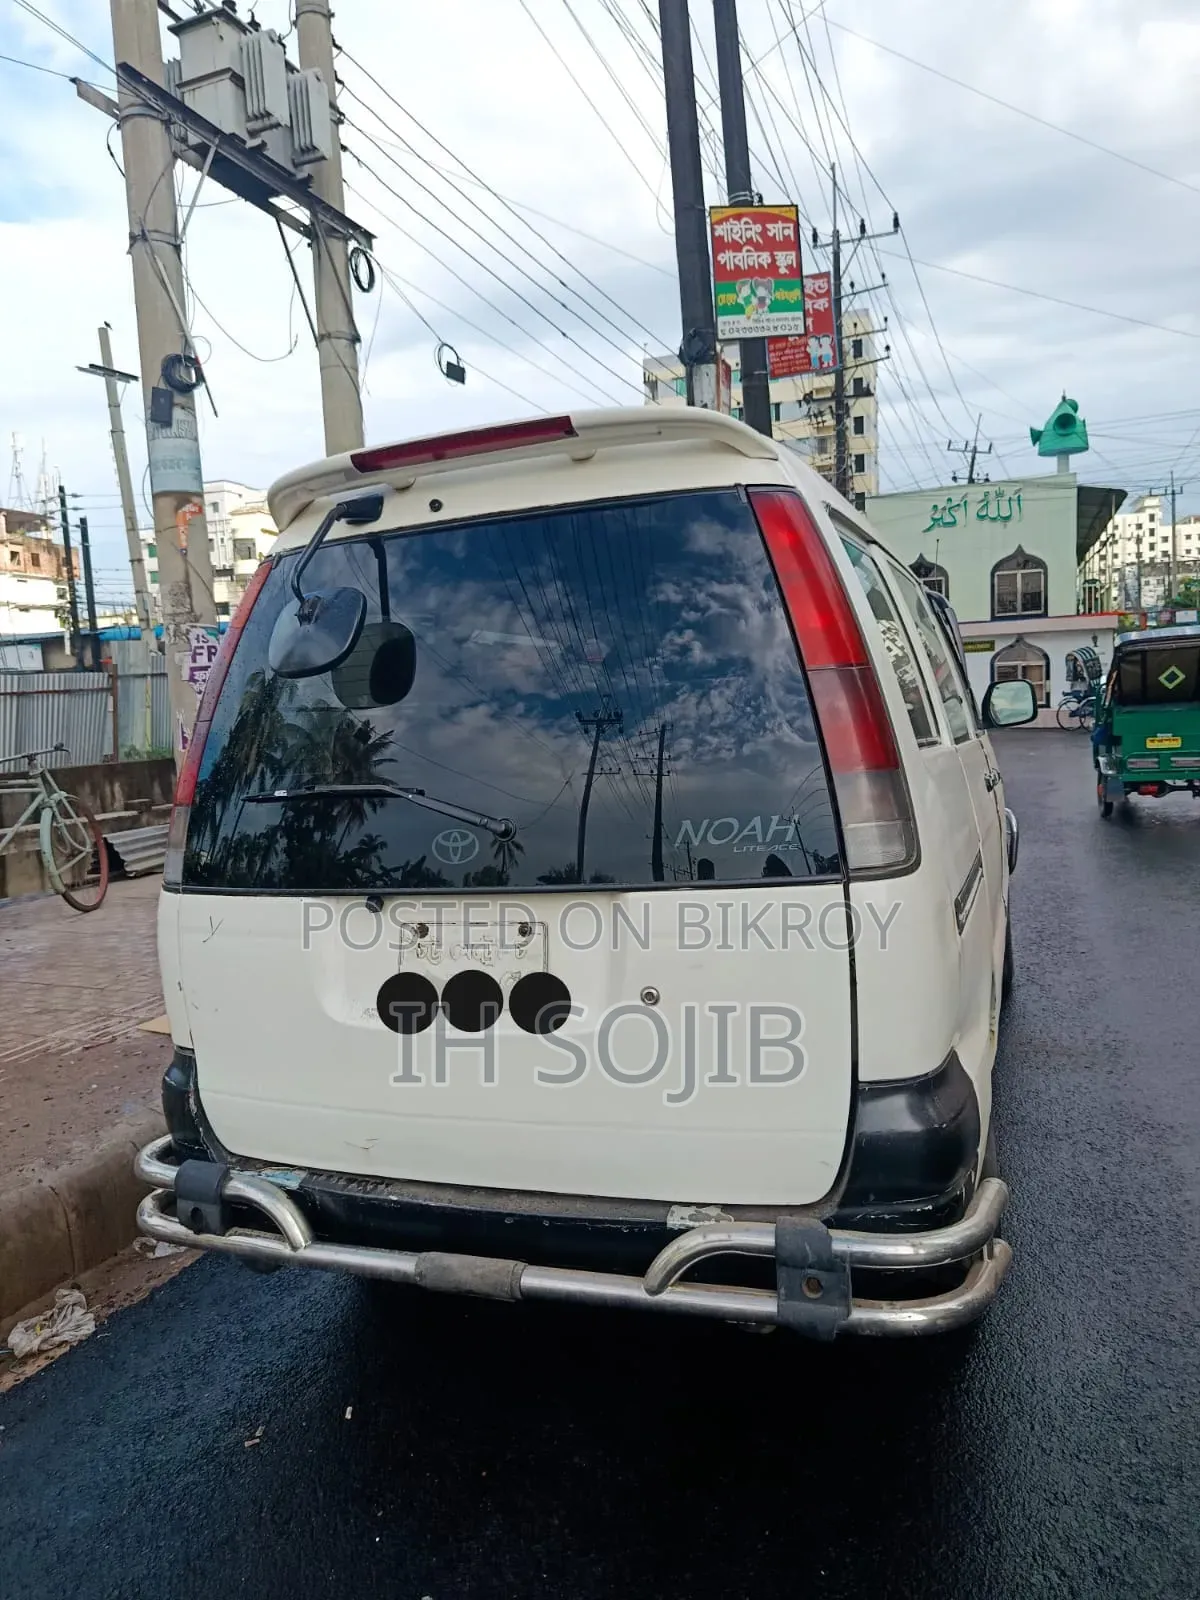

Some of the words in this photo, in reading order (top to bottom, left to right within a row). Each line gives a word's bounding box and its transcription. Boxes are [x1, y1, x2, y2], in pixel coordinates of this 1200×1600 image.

[713, 217, 764, 245] শাইনিং
[765, 220, 794, 242] সান
[717, 245, 771, 271] পাবলিক
[773, 251, 797, 274] স্কুল
[674, 814, 799, 848] NOAH
